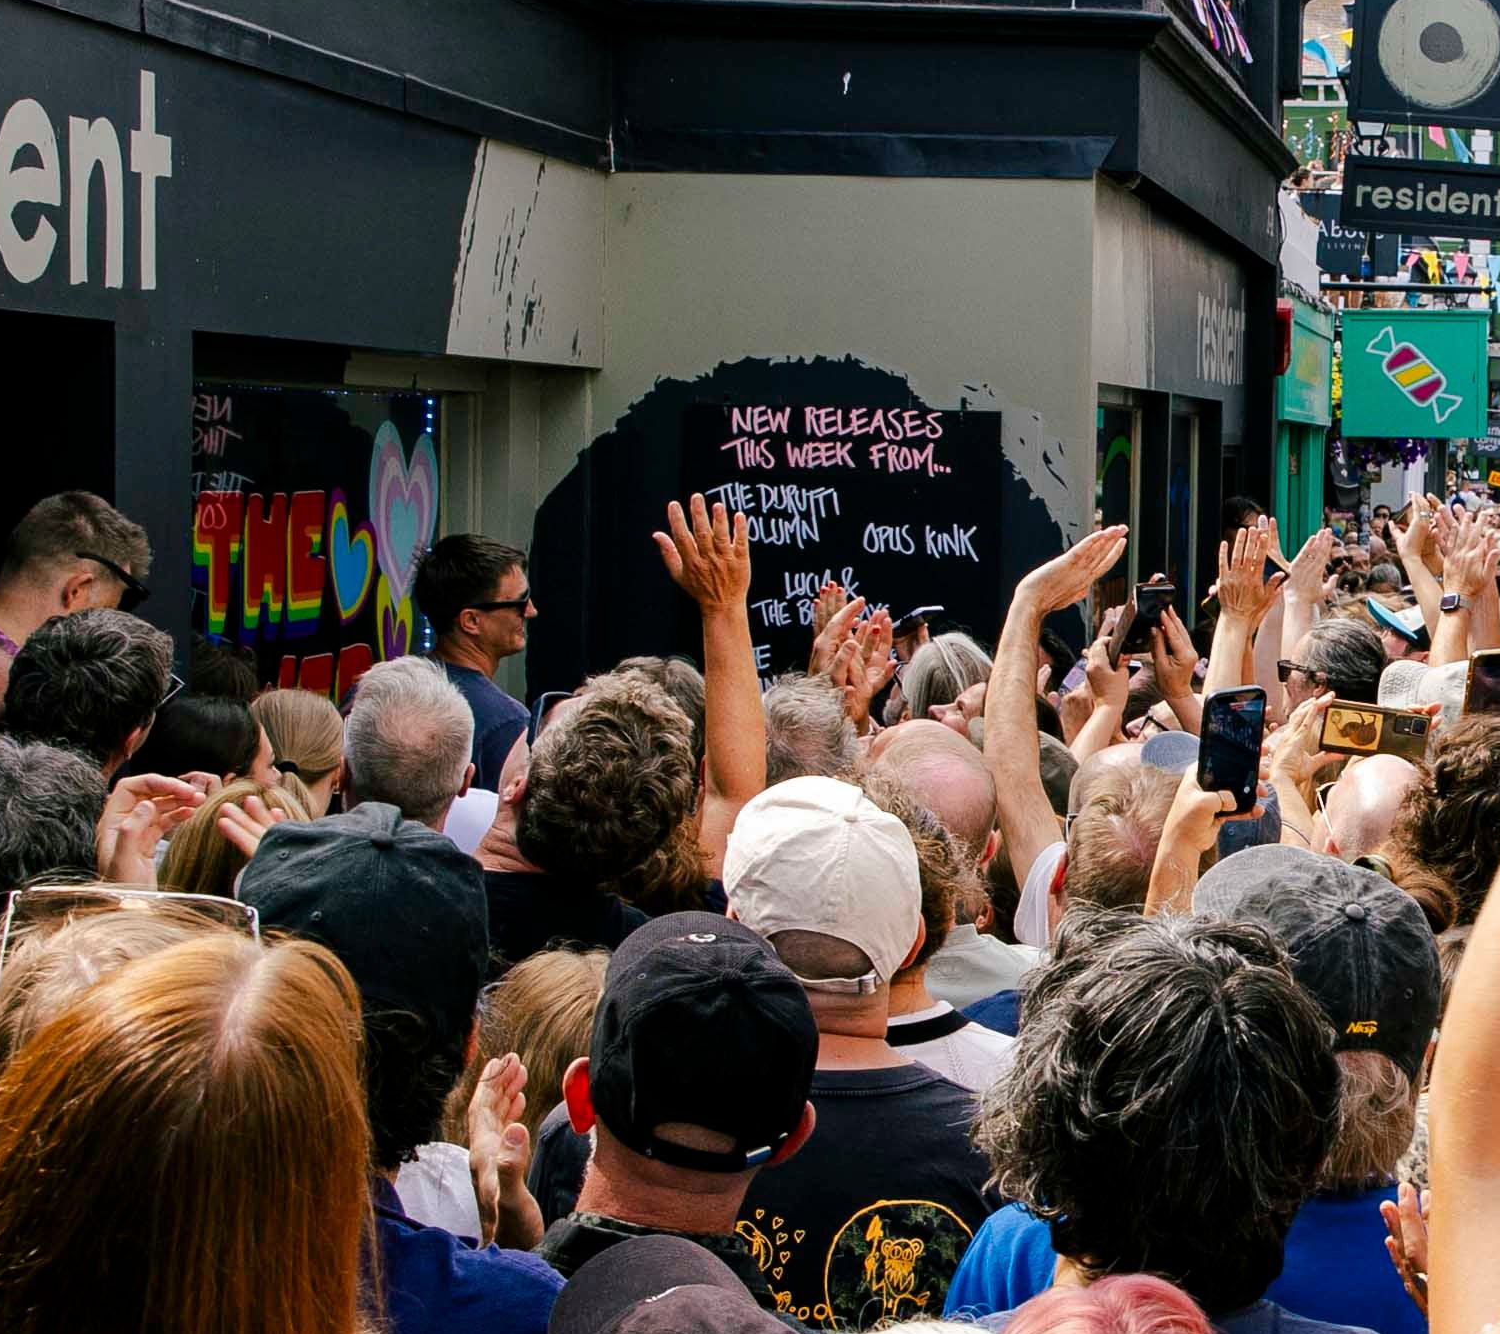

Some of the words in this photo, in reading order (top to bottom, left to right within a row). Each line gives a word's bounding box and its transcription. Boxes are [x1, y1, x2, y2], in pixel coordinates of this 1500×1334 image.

[1196, 279, 1246, 387] resident
[732, 405, 791, 435] NEW
[804, 406, 943, 441] RELEASES
[720, 436, 776, 470] THIS
[786, 441, 856, 469] WEEK
[869, 441, 952, 478] FROM...
[705, 481, 755, 513] THE
[754, 482, 840, 519] DURUTTI
[747, 515, 821, 550] OLUMN
[862, 522, 916, 556] OPUS
[192, 490, 326, 635] THE
[841, 566, 860, 599] &
[750, 598, 792, 627] THE
